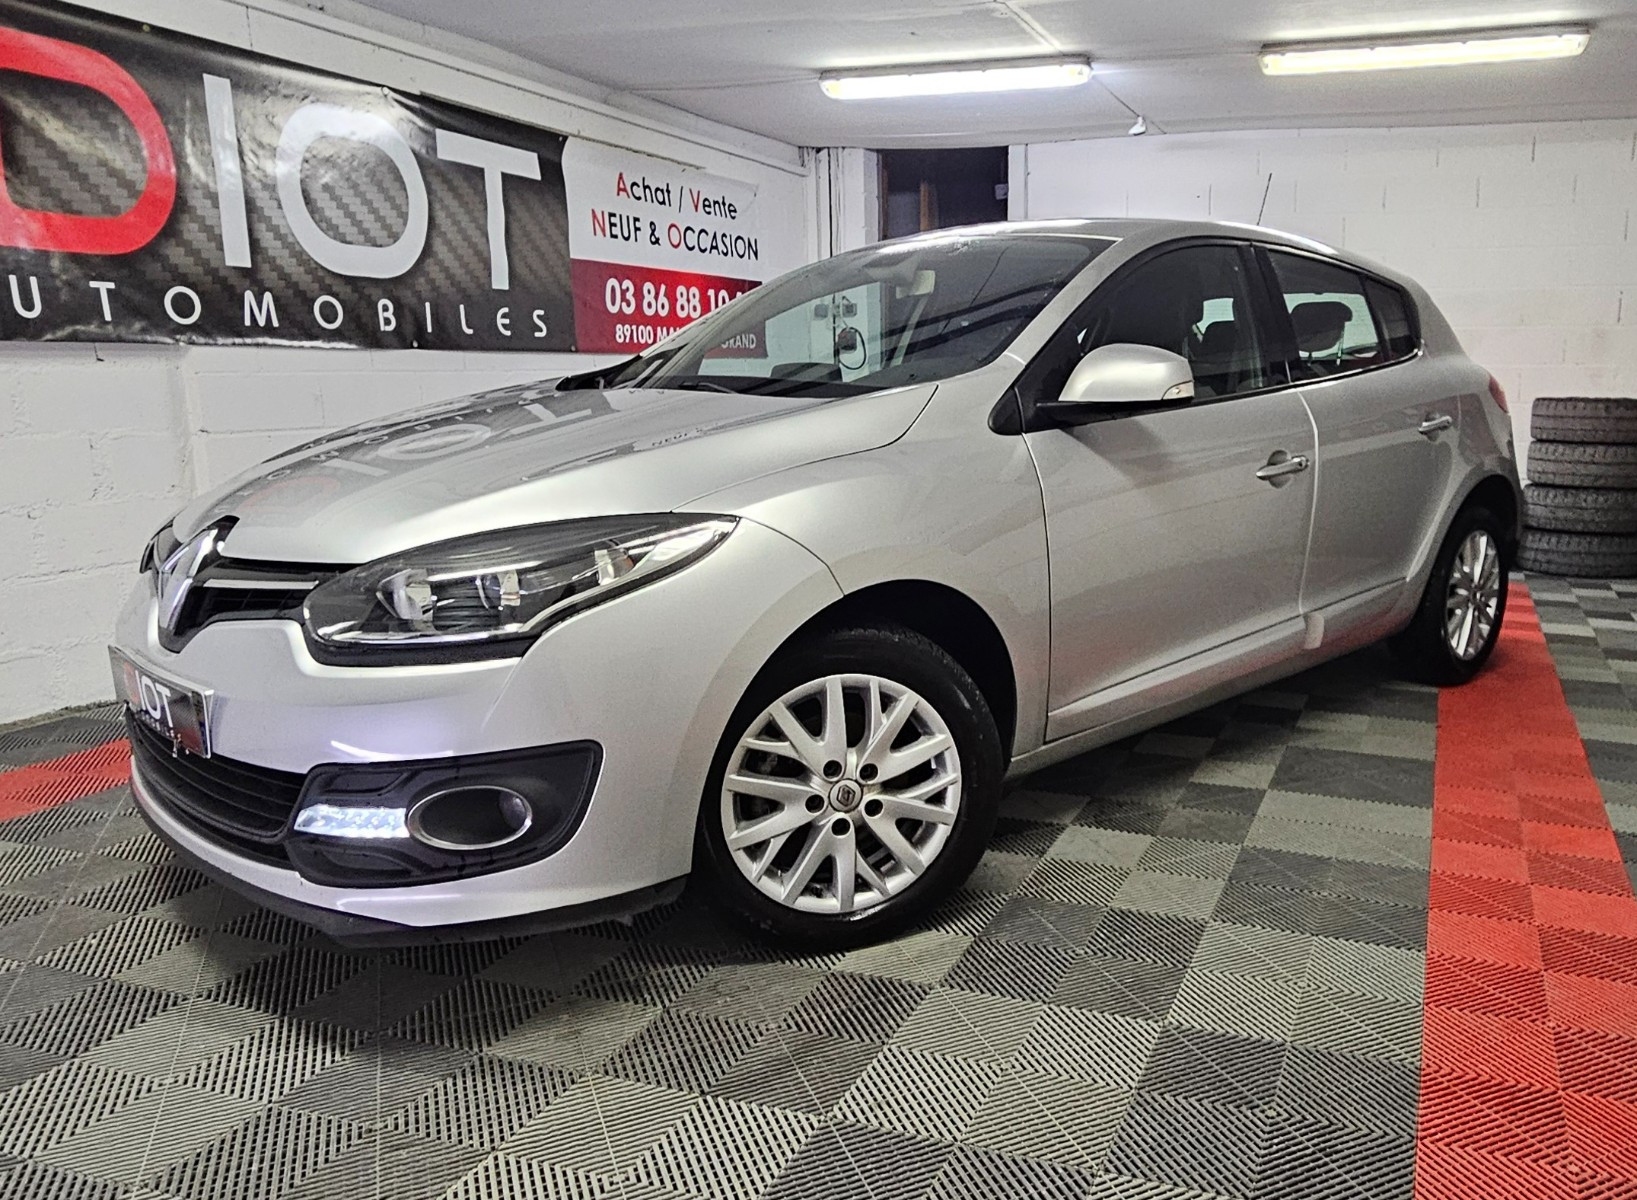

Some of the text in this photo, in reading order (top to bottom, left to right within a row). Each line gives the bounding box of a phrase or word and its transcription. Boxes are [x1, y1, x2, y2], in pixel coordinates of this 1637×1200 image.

[0, 26, 542, 291] DIOT
[616, 171, 672, 208] Achat
[689, 188, 738, 220] Vente
[591, 208, 759, 261] NEUF & OCCASION
[605, 277, 636, 315] 03
[642, 281, 670, 317] 86
[675, 285, 702, 319] 88
[615, 323, 654, 344] 89100
